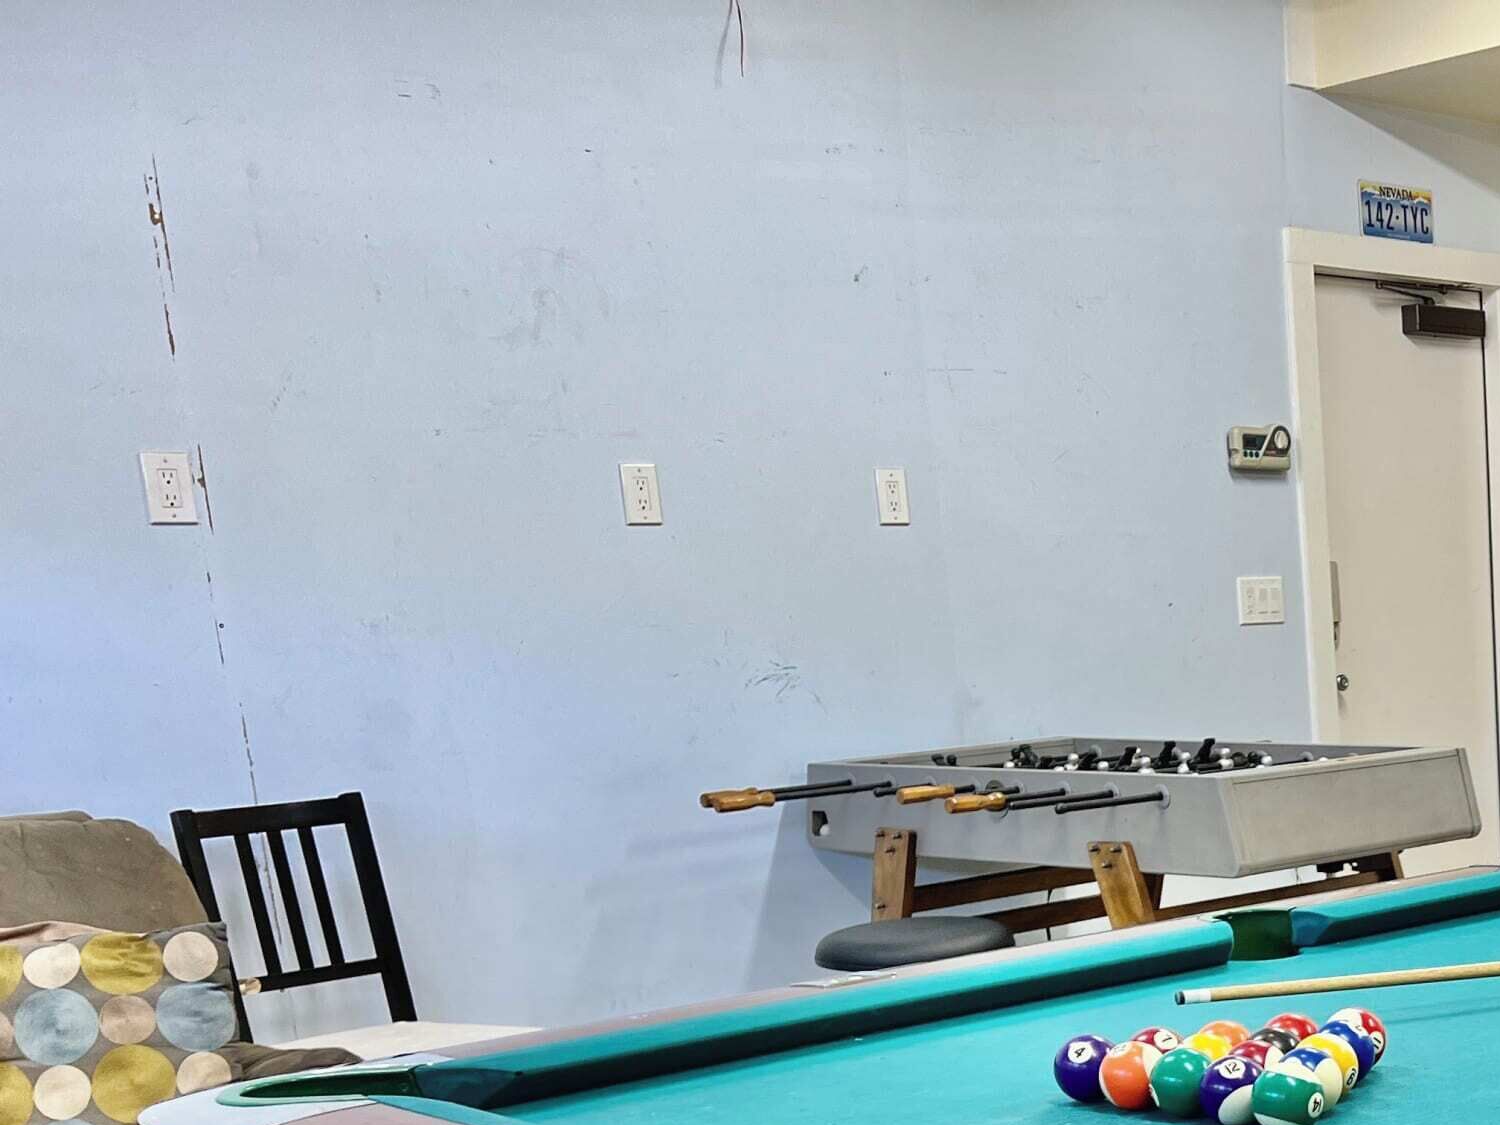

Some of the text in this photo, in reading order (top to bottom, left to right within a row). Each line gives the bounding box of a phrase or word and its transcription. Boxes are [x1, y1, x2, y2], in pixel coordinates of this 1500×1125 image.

[1379, 186, 1414, 200] NEVADA
[1074, 1047, 1086, 1058] 4
[1225, 1062, 1241, 1074] 12
